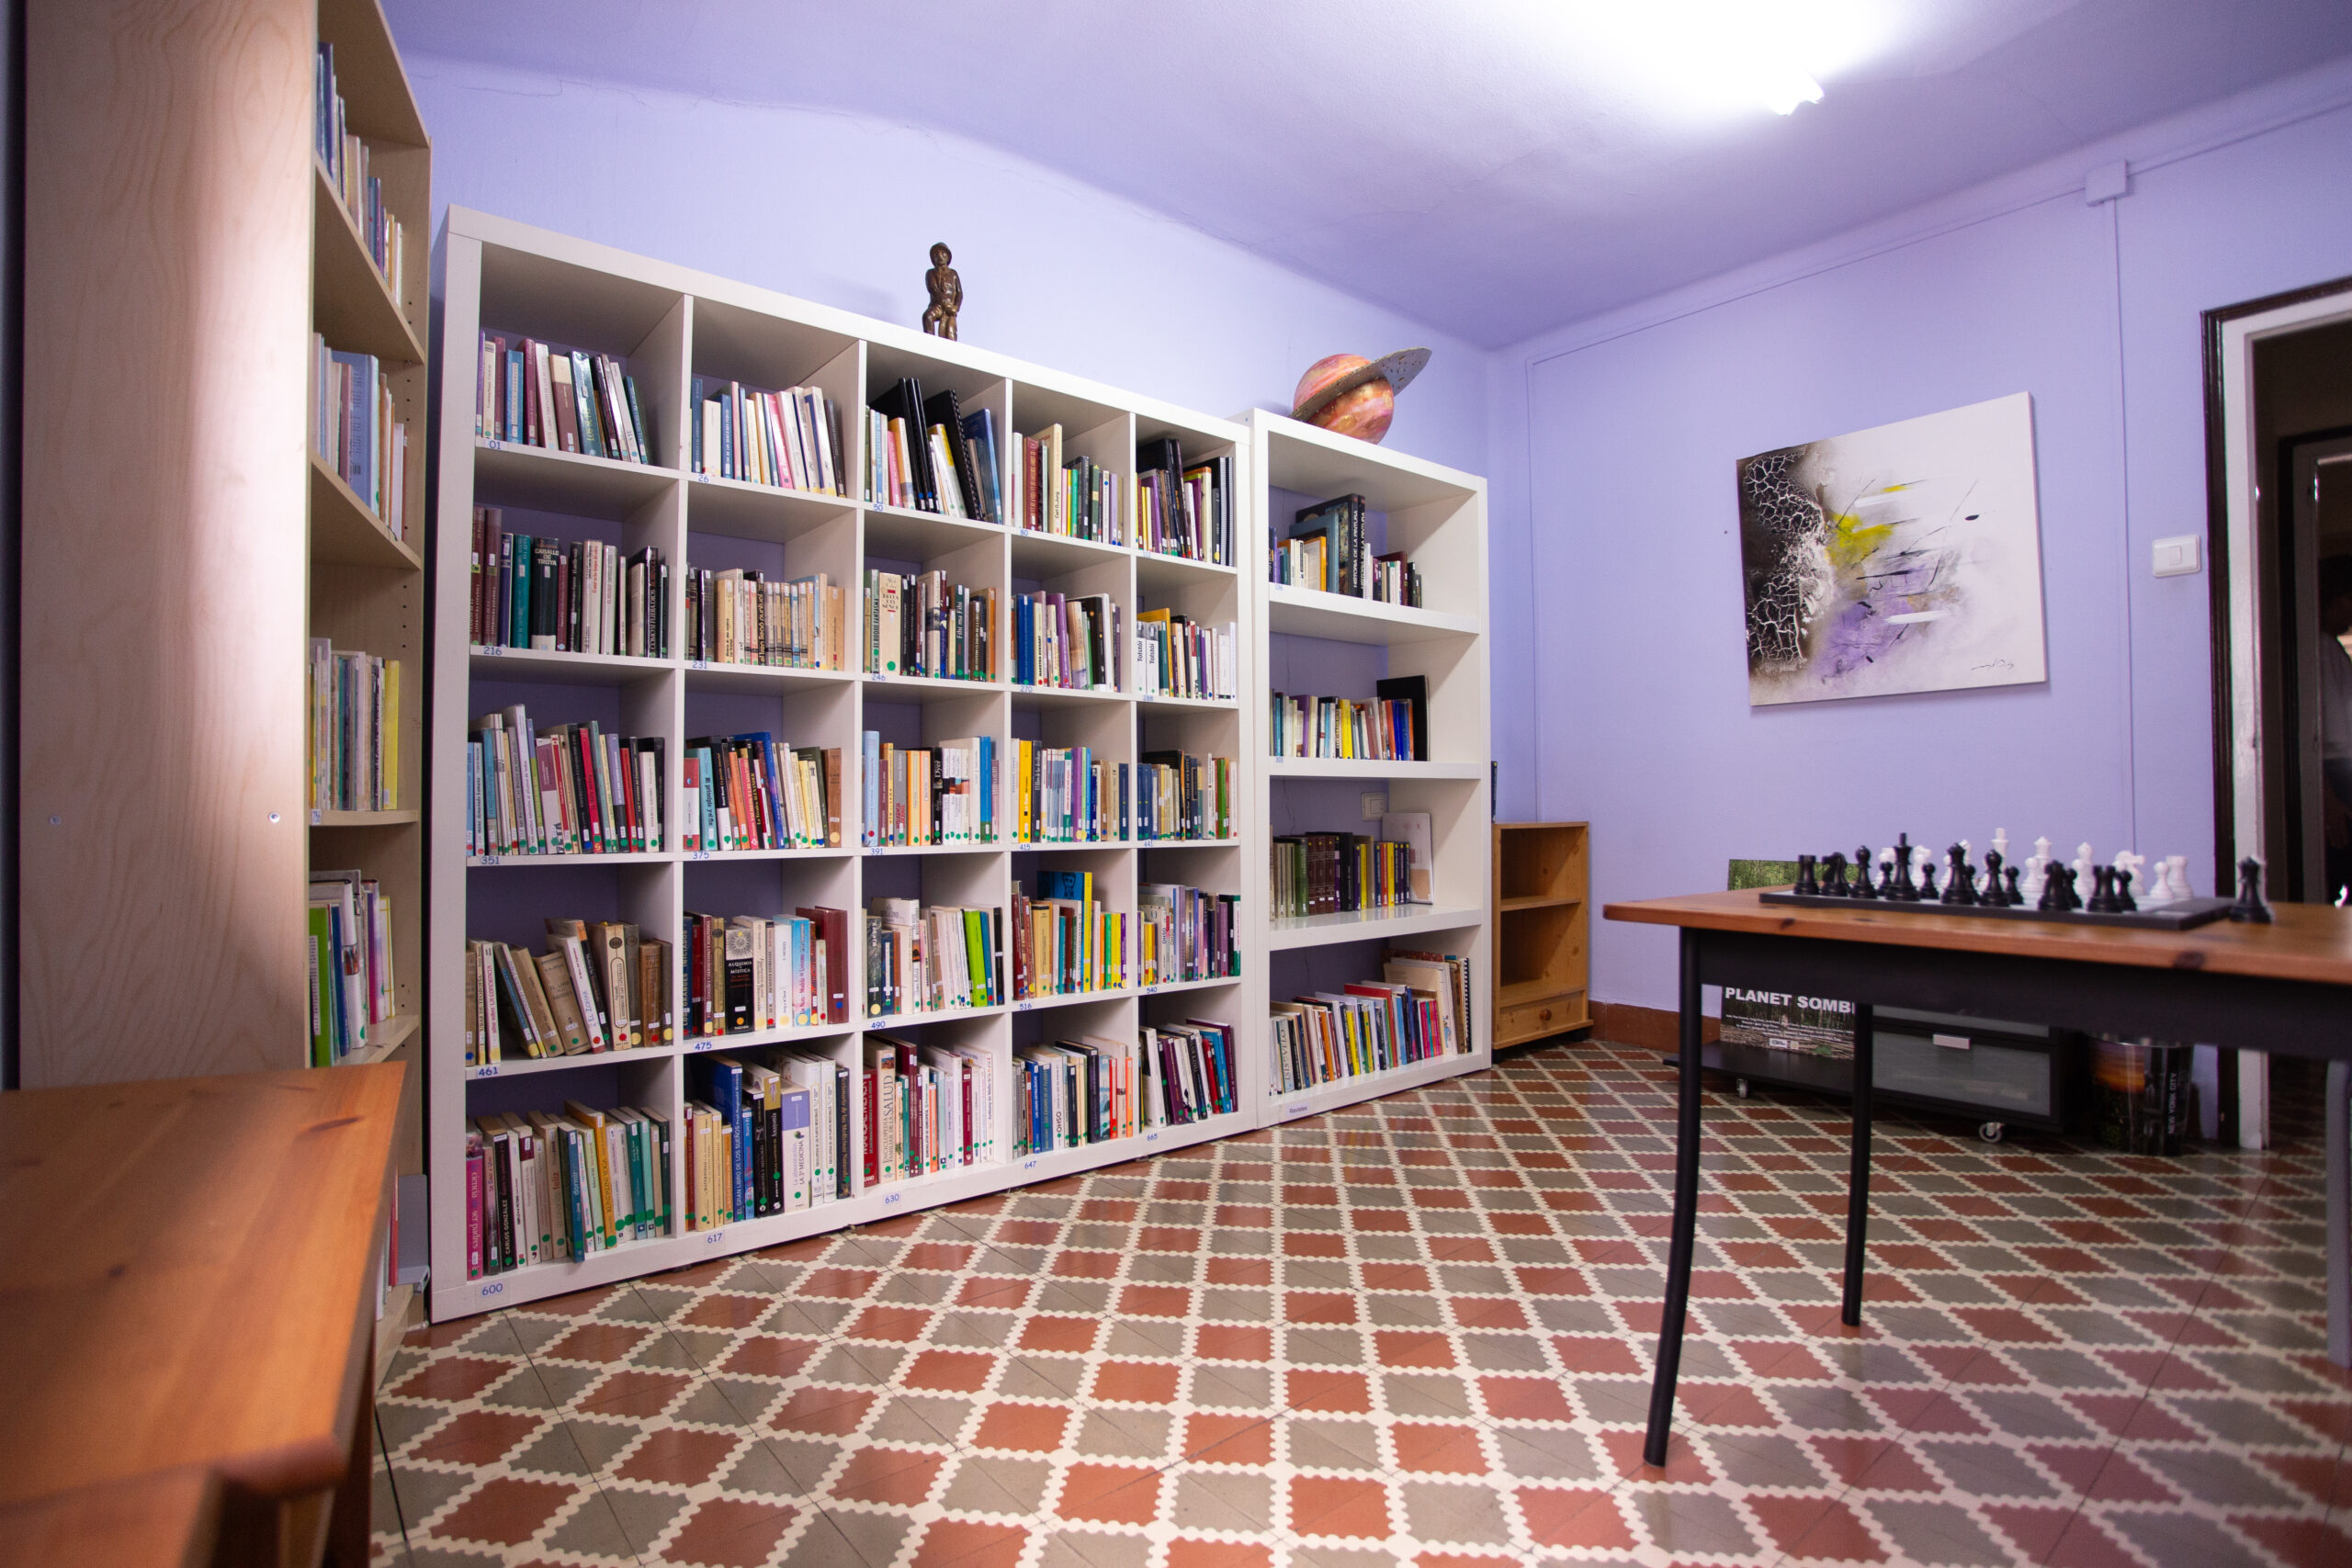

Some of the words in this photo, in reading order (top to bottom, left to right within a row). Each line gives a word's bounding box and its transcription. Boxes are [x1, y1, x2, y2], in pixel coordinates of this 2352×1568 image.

[698, 474, 708, 483] 26
[874, 503, 883, 512] 50
[484, 647, 502, 655] 216
[870, 848, 884, 856] 391
[481, 856, 499, 864] 351
[1724, 987, 1792, 1006] PLANET
[1796, 996, 1855, 1014] SOMB
[871, 1021, 886, 1029] 490
[695, 1042, 712, 1051] 475
[479, 1066, 498, 1077] 461
[883, 1075, 894, 1117] SALUD
[1023, 1160, 1035, 1169] 647
[571, 1172, 580, 1195] dormir
[886, 1193, 899, 1203] 630
[471, 1224, 480, 1248] padres
[707, 1233, 722, 1244] 617
[482, 1283, 503, 1295] 600
